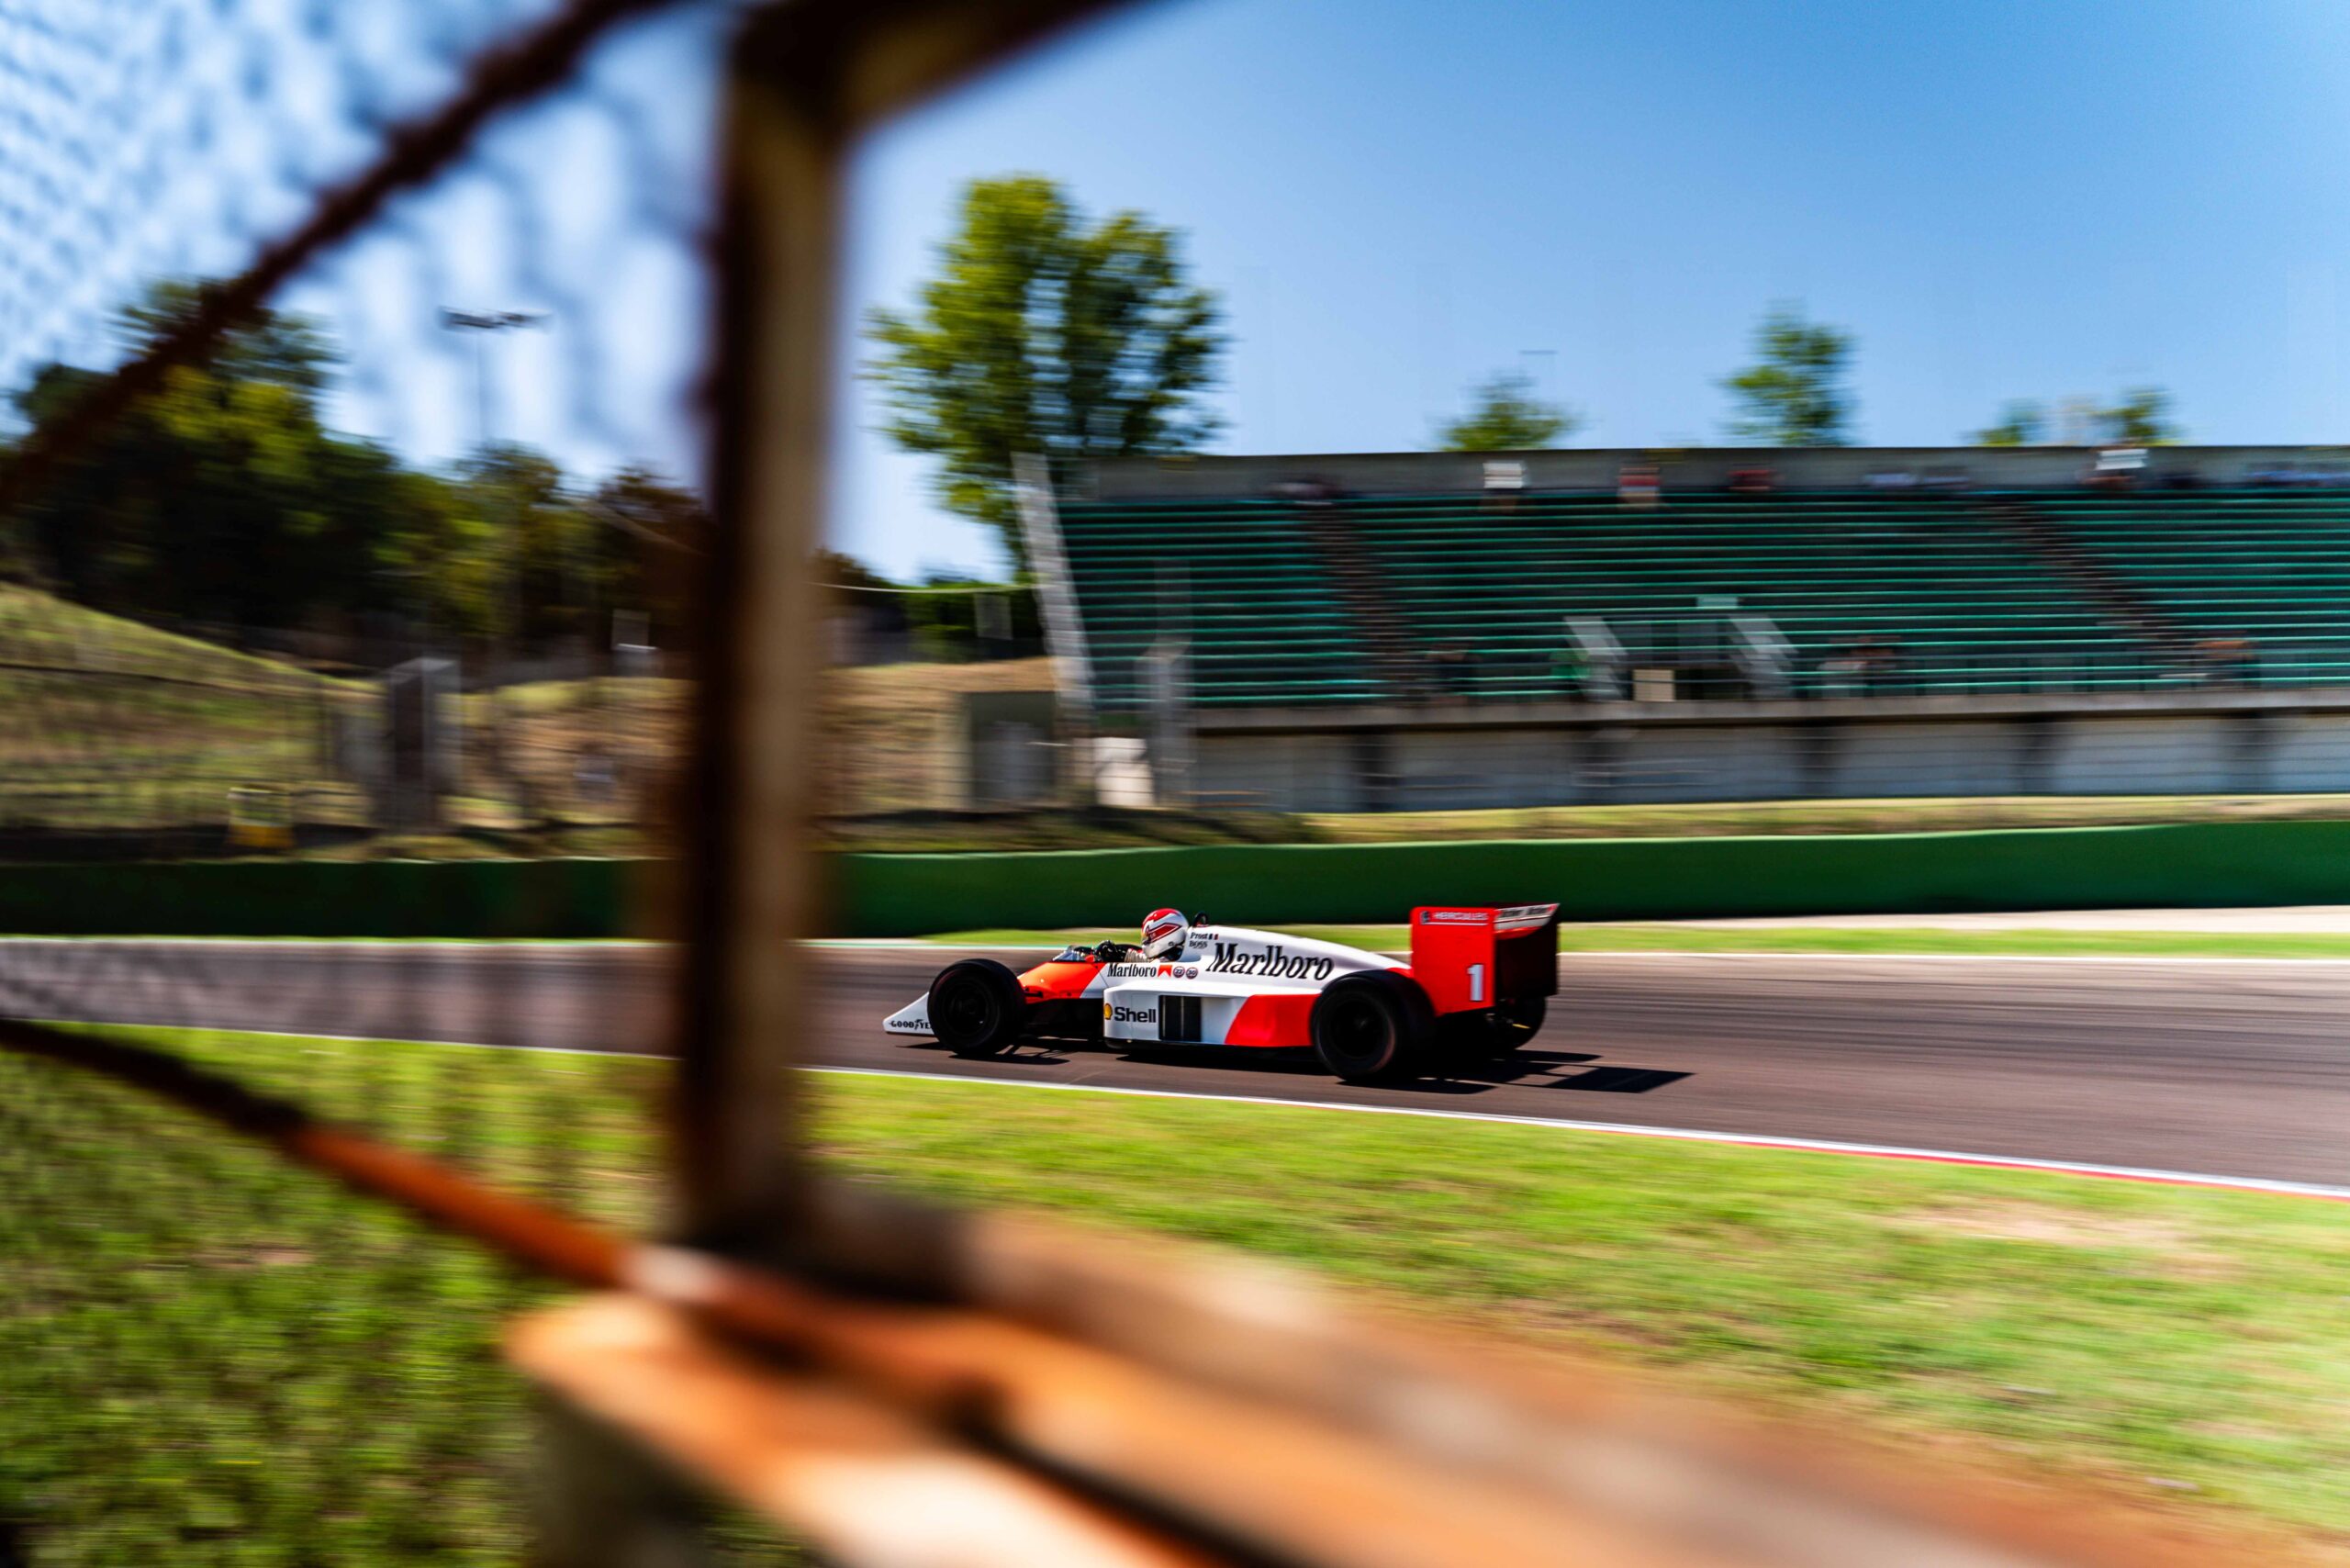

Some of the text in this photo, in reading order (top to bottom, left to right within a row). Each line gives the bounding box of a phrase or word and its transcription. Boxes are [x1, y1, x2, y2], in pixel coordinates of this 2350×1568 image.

[1206, 942, 1335, 981] Marlboro
[1107, 963, 1157, 978] Marlboro
[1467, 964, 1484, 1002] 1
[1113, 1006, 1157, 1023] Shell
[890, 1019, 933, 1030] GOODYE
